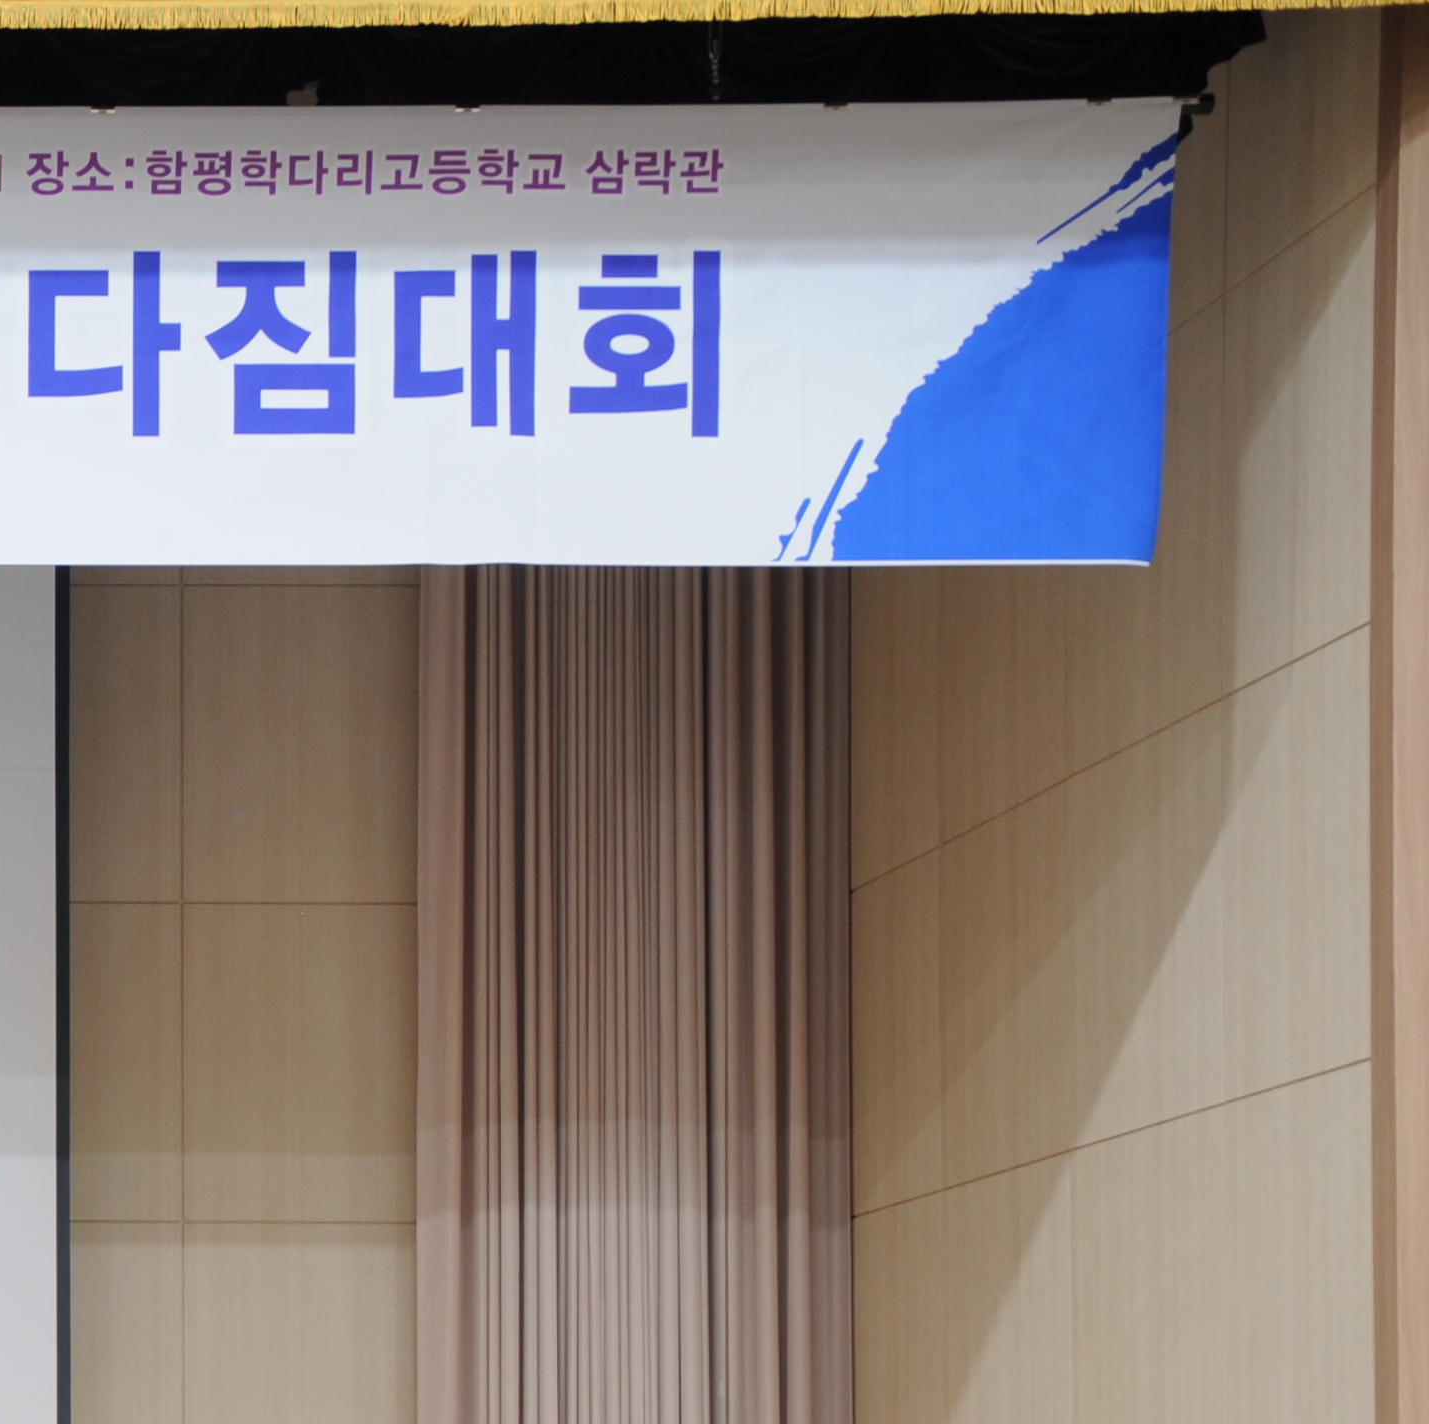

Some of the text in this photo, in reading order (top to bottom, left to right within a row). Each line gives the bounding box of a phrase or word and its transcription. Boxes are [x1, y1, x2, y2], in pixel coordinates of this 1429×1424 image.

[27, 149, 723, 195] 장소:함평학다리고등학교 삼락관
[28, 249, 721, 437] 다짐대회
